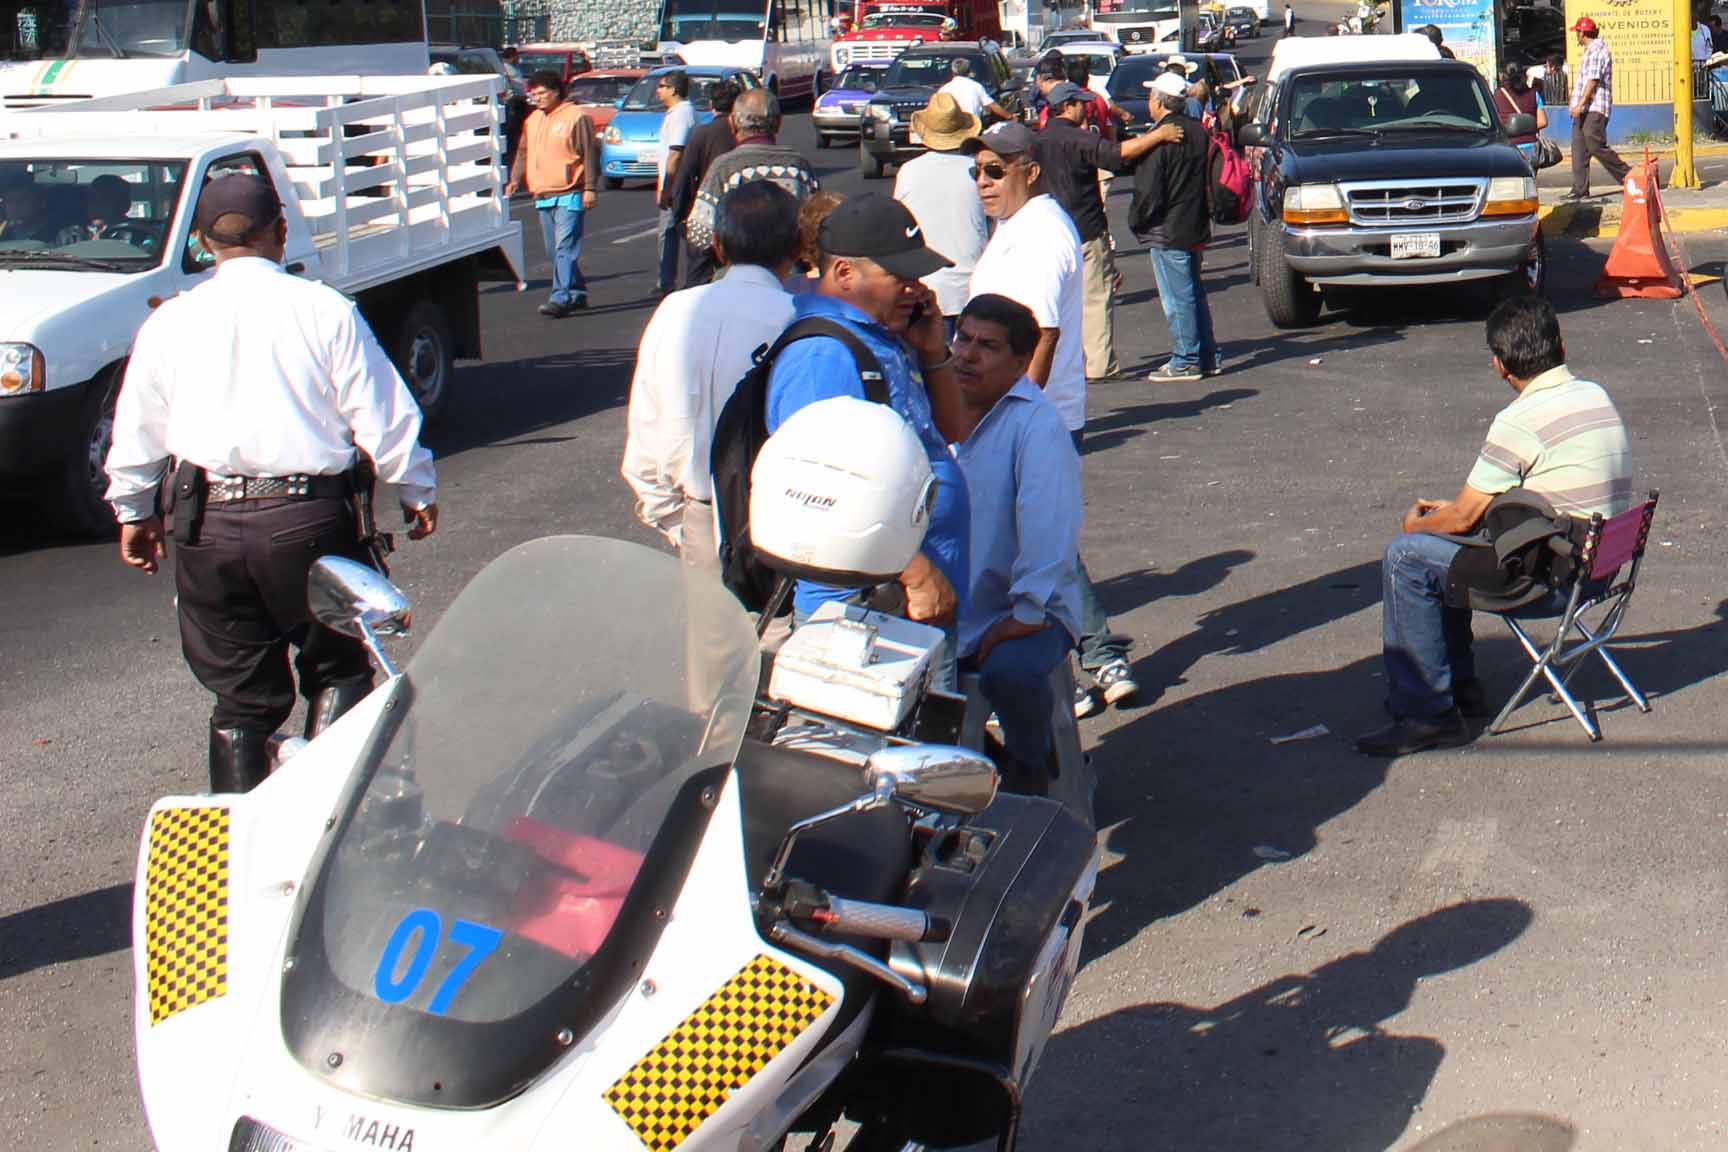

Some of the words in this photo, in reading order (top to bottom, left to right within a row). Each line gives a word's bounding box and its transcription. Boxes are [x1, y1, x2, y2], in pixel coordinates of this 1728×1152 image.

[1598, 20, 1669, 30] NVENIDOS
[374, 906, 504, 1016] 07
[315, 1104, 415, 1152] YMAHA
